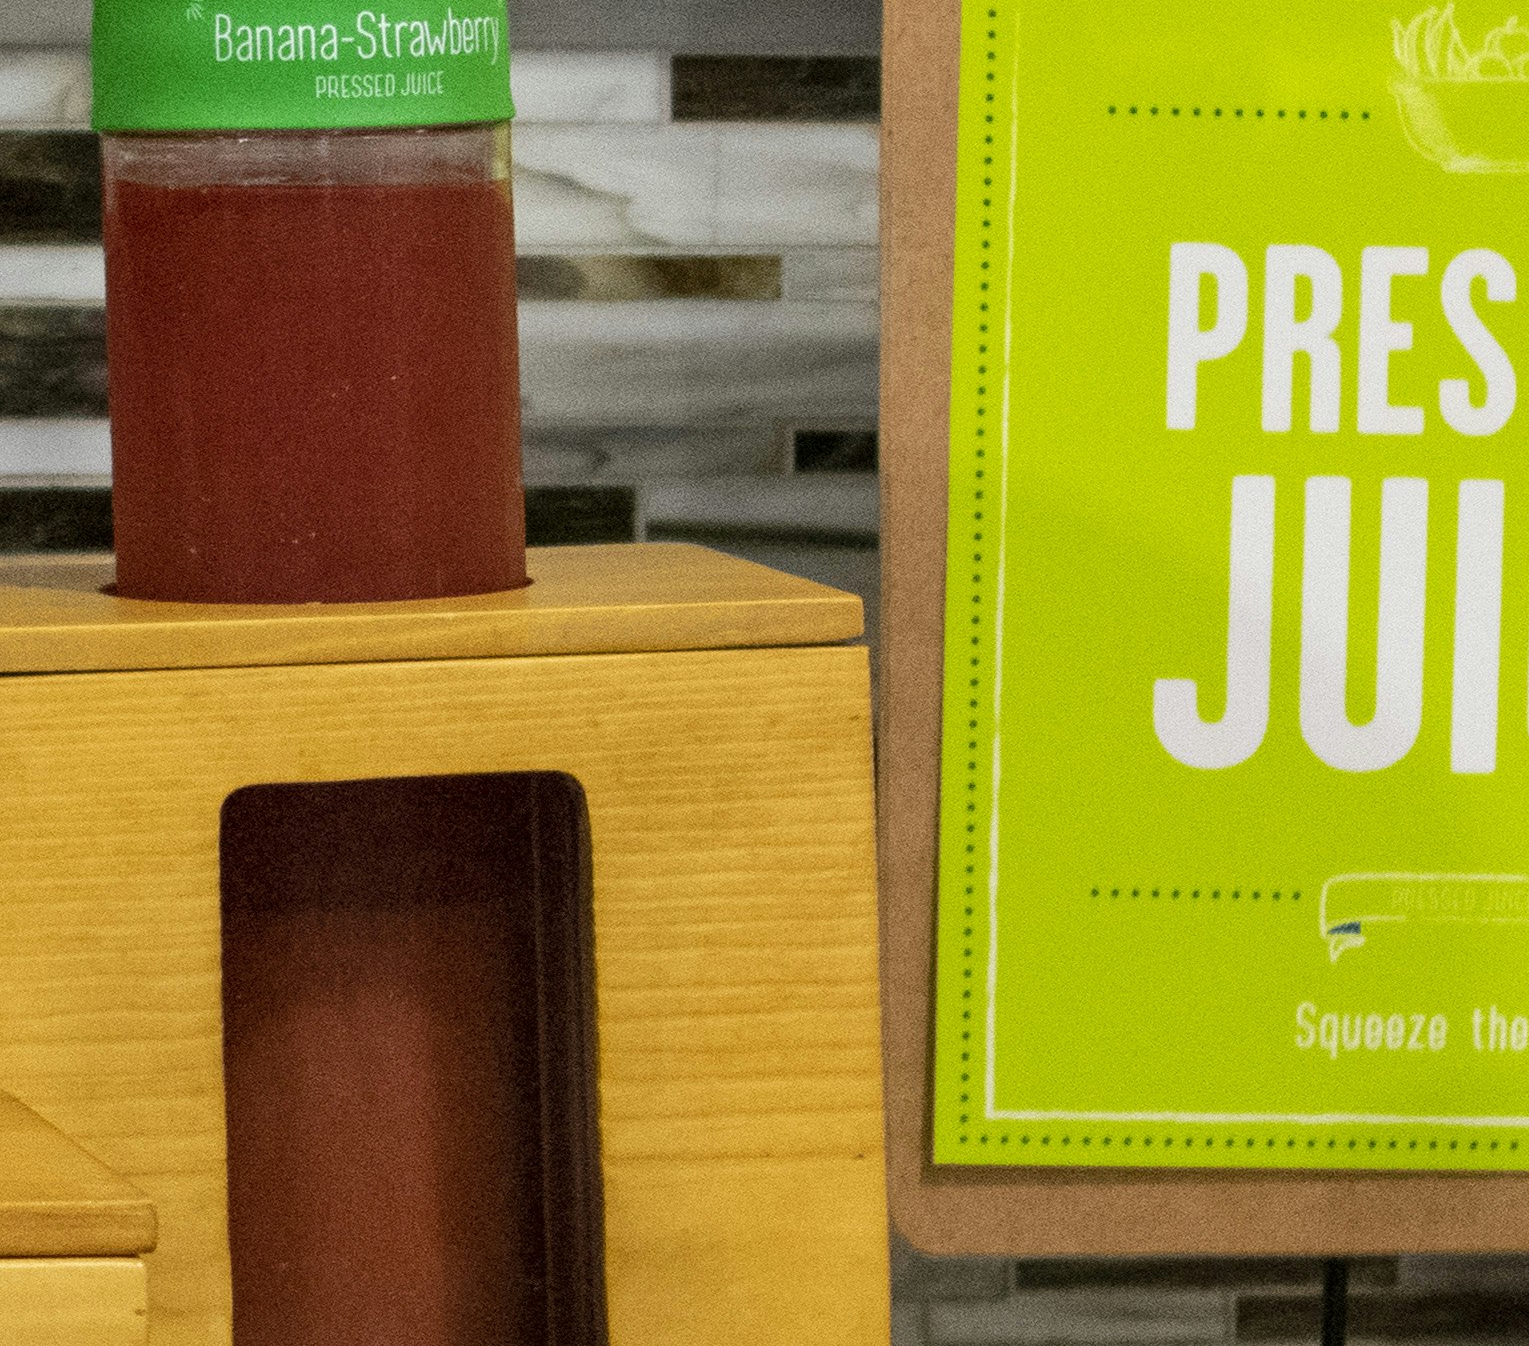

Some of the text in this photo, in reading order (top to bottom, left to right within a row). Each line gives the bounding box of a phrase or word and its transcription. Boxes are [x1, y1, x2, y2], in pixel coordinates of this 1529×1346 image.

[213, 7, 500, 66] Banana-Strawberry
[316, 70, 444, 100] PRESSED JUICE
[1295, 1000, 1446, 1060] Squeeze
[1472, 1005, 1529, 1052] the
